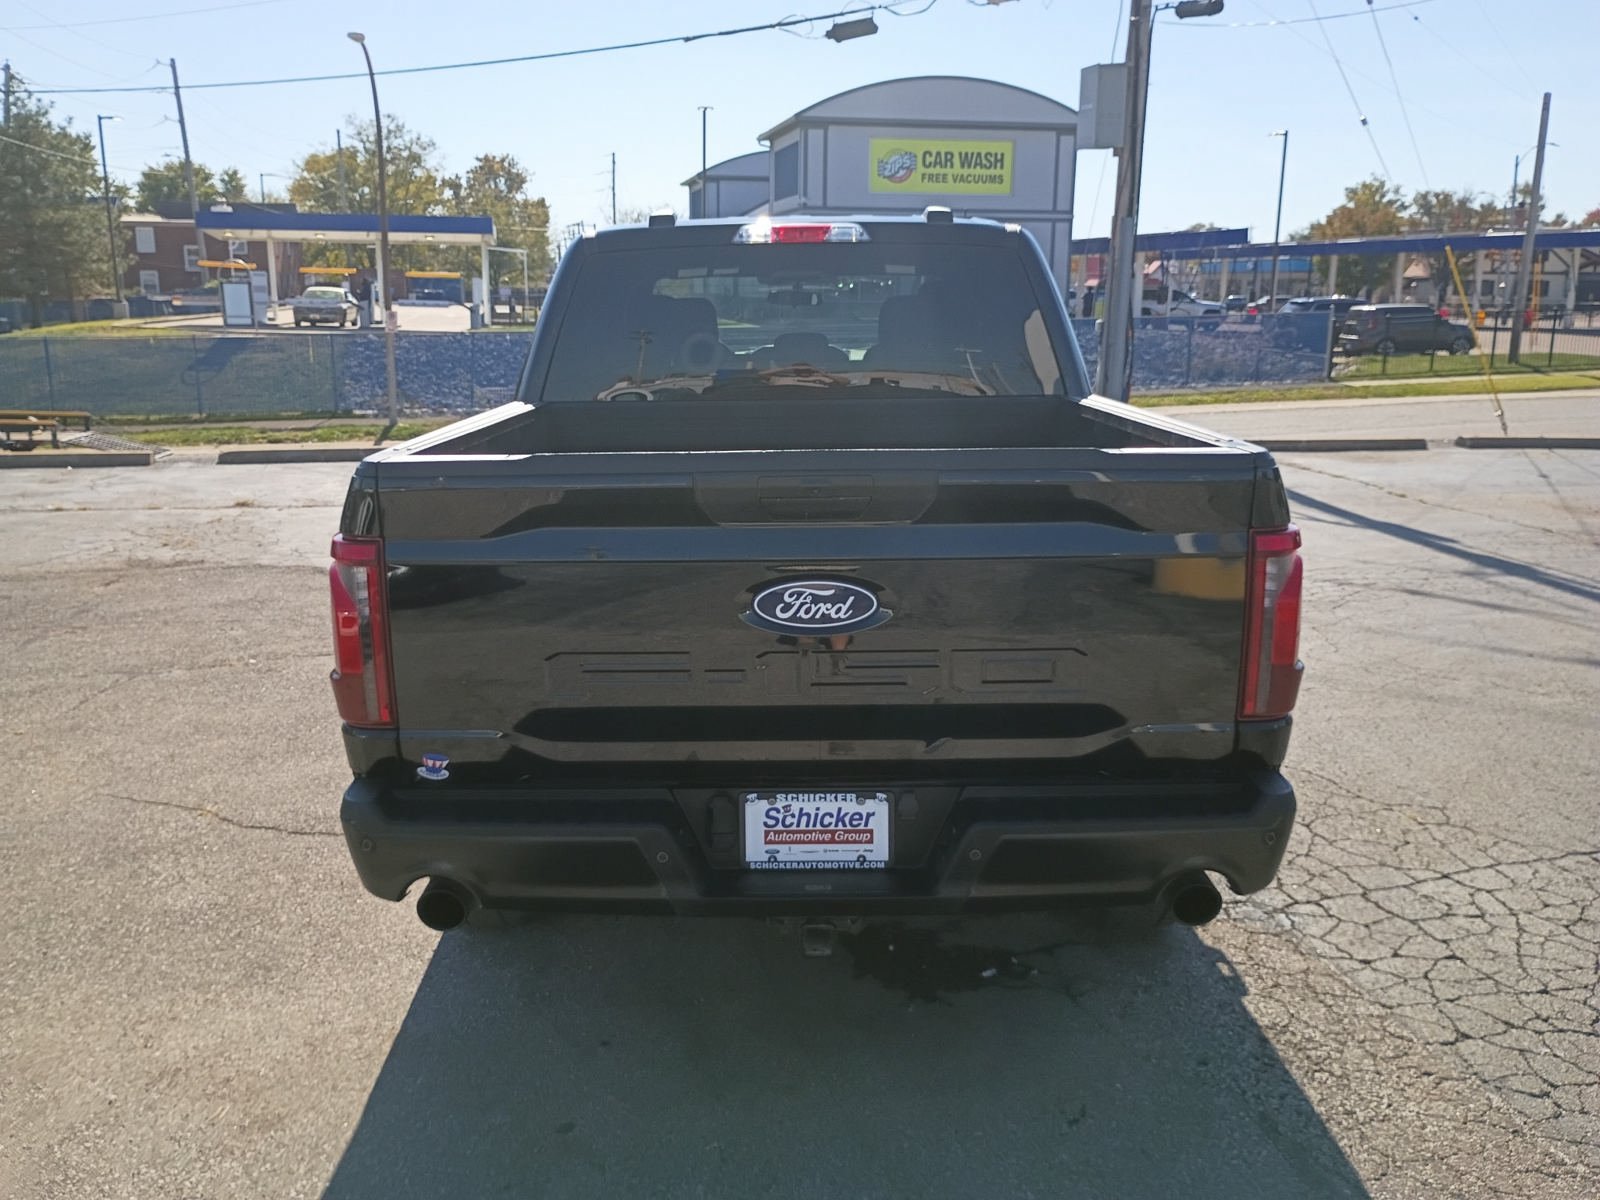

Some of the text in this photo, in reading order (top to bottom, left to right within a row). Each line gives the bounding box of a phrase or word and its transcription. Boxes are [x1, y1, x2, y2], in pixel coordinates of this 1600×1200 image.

[884, 155, 912, 174] ZIPS
[921, 151, 1005, 170] CAR WASH
[921, 173, 1004, 184] FREE VACUUMS
[775, 588, 855, 619] Ford
[776, 793, 857, 803] SCHICKER
[763, 806, 875, 829] Schicker
[766, 831, 871, 843] Automotive Group
[750, 861, 885, 869] SCHICKERAUTOMOTIVE.COM
